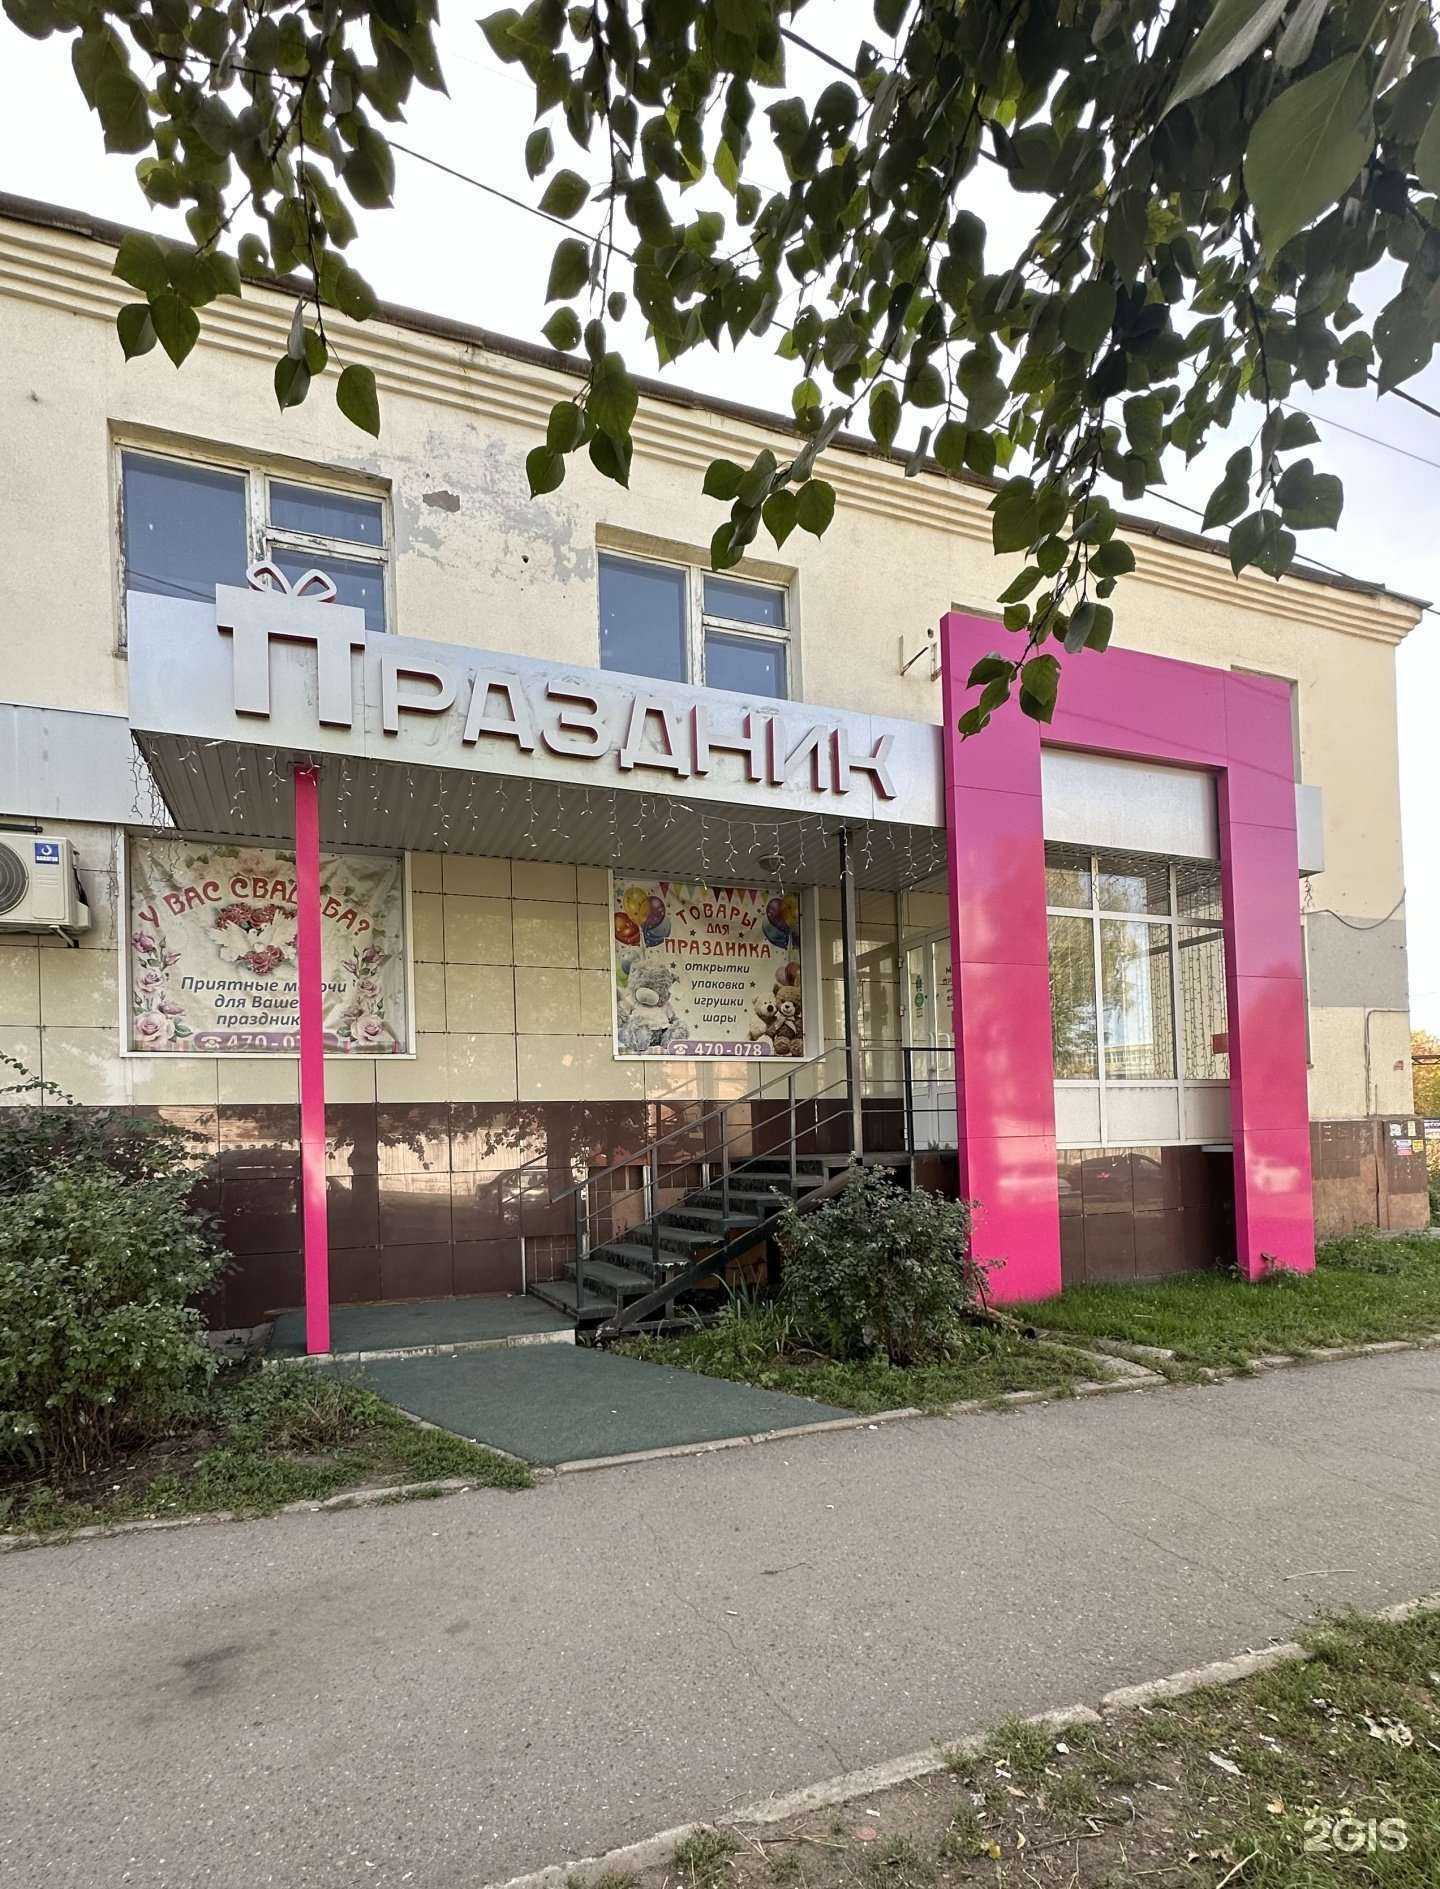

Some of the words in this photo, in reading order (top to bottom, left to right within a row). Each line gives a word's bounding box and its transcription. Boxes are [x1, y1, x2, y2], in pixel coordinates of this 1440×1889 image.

[139, 905, 160, 929] У
[163, 880, 222, 916] ВАС
[231, 876, 370, 936] СВАДБА?
[676, 903, 757, 930] ТОВАРЫ
[664, 938, 771, 959] ПРАЗДНИКА
[684, 961, 750, 974] открытки
[181, 976, 279, 993] Приятные
[283, 981, 347, 993] мочи
[691, 979, 745, 991] упаковка
[214, 994, 246, 1008] для
[251, 995, 299, 1009] Ваше
[694, 997, 744, 1008] игрушки
[216, 1012, 301, 1028] праздник
[702, 1014, 737, 1025] шары
[227, 1035, 301, 1049] 470-0
[694, 1043, 762, 1056] 470-078
